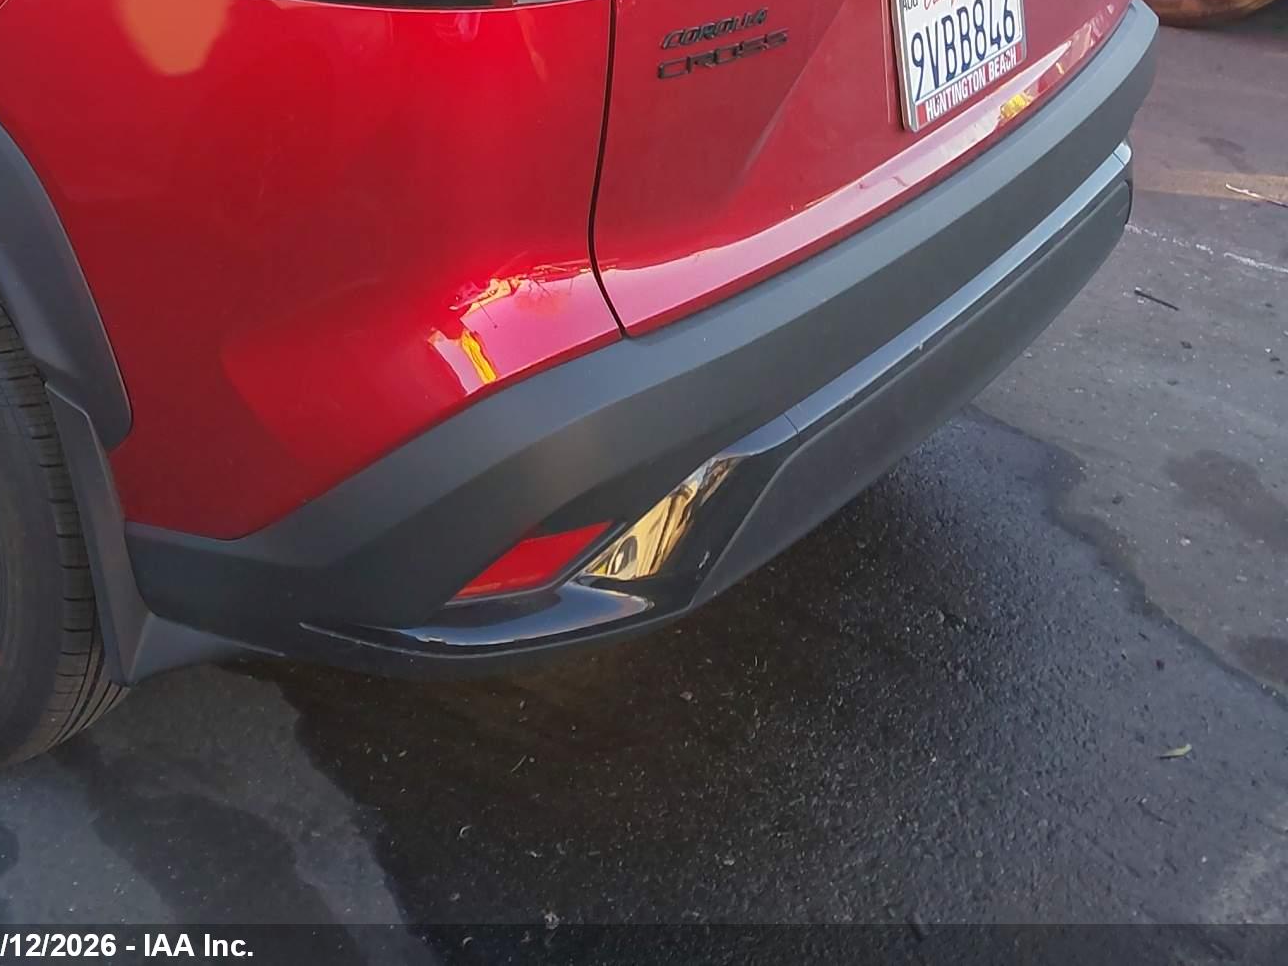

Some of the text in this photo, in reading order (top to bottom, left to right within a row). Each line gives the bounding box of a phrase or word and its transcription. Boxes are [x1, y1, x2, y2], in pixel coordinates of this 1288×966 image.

[658, 28, 789, 79] CROSS
[661, 8, 768, 50] COROLLA
[925, 45, 1017, 122] HUNTINGTON BEACH
